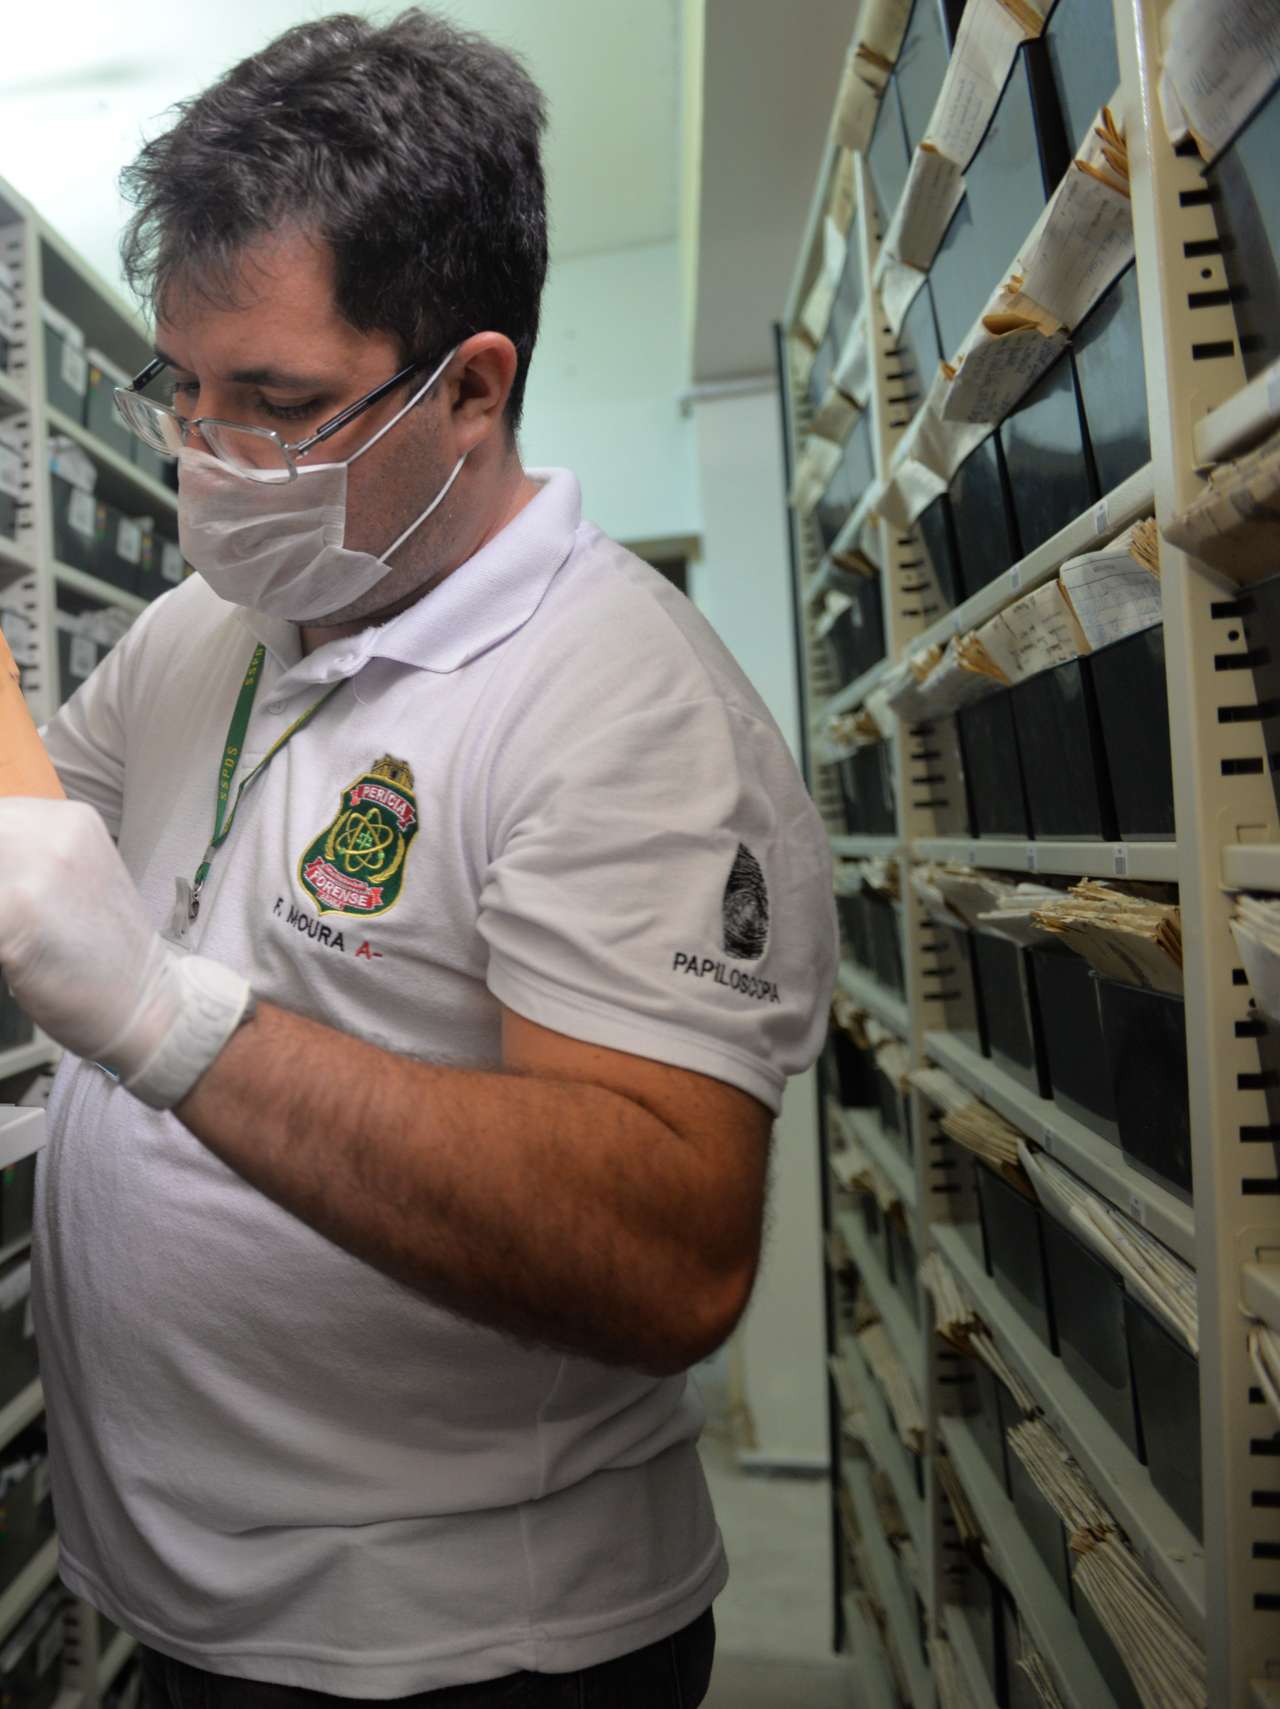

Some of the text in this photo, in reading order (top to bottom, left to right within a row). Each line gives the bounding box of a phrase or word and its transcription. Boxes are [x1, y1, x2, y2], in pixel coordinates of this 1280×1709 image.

[221, 747, 238, 800] SSPDS
[312, 870, 368, 907] FORENSE
[286, 906, 344, 952] MOURA
[672, 952, 781, 1004] PAPILOSCOPIA
